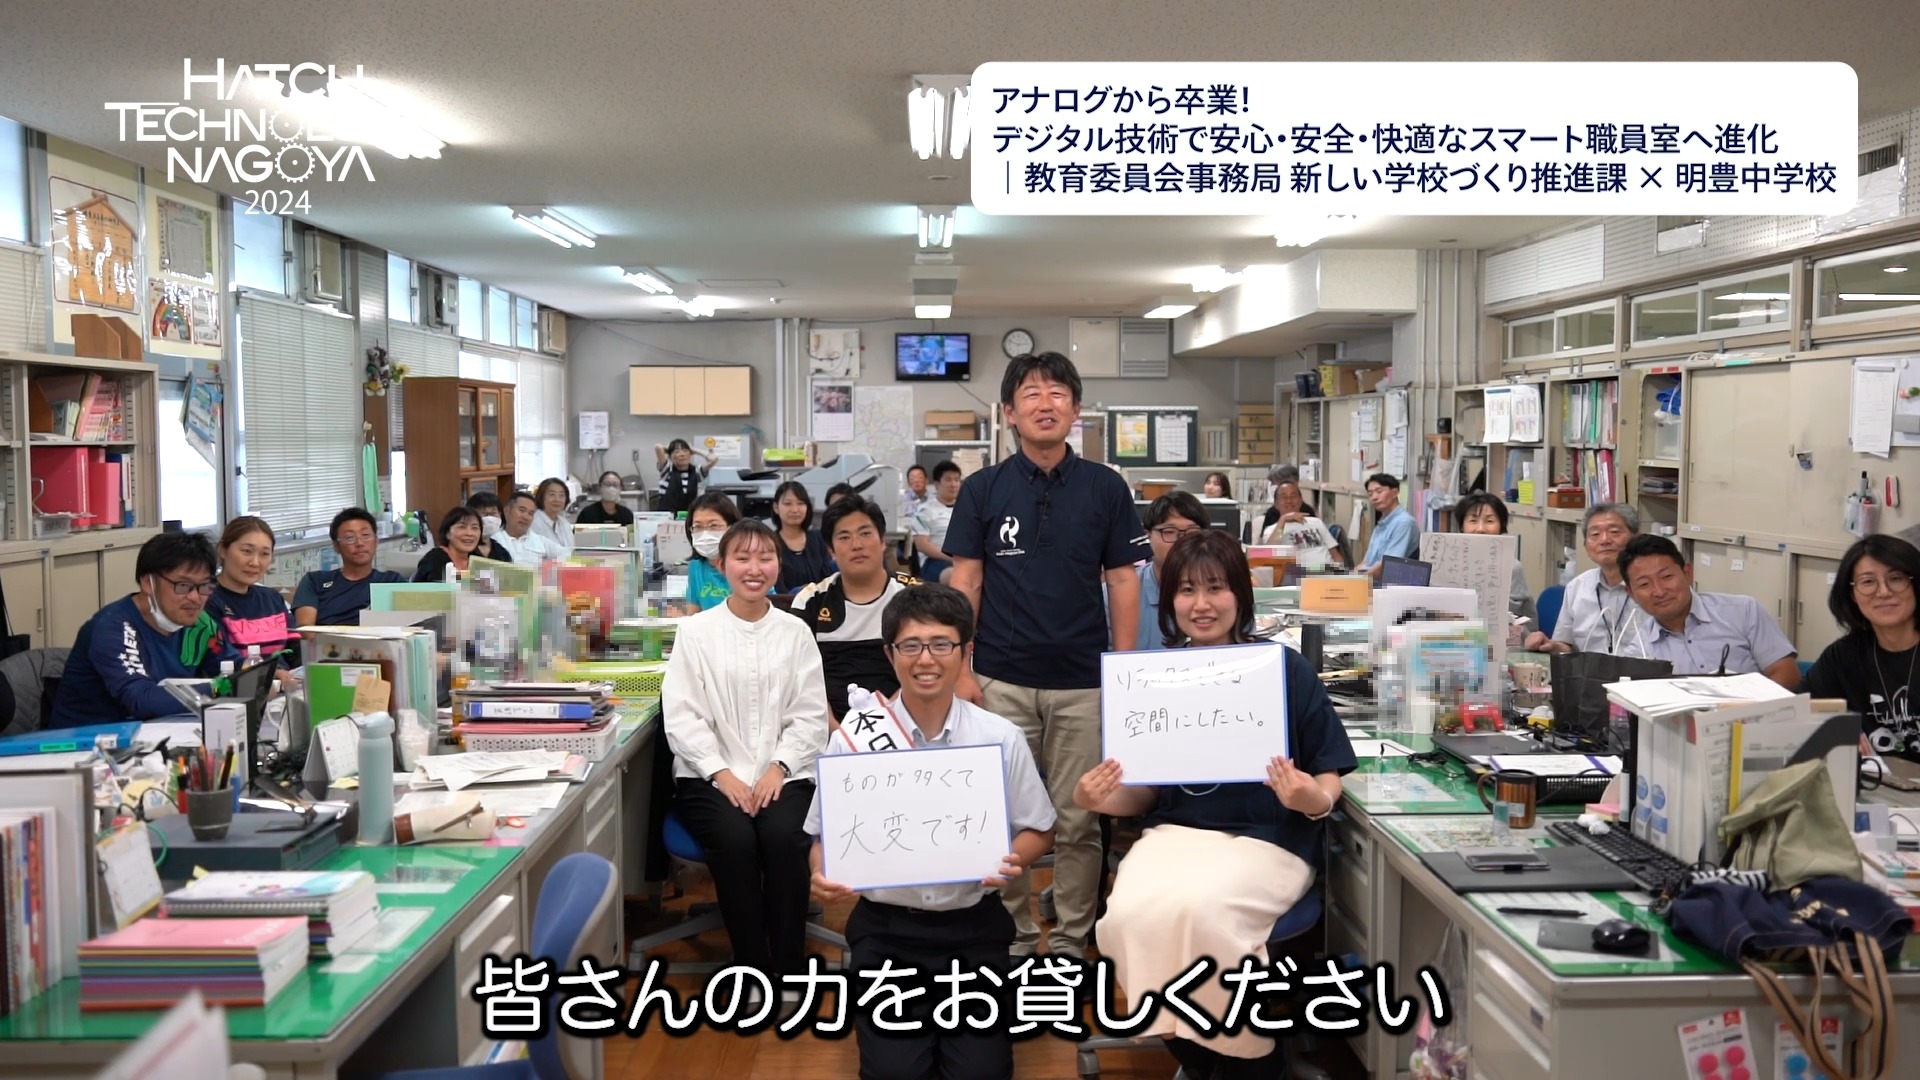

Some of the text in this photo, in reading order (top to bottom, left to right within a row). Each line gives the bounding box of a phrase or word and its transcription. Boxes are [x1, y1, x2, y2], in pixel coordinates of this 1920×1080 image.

[1124, 707, 1264, 739] 空間にしたい。
[842, 768, 974, 794] ものが多くて
[840, 810, 988, 861] 大変です!
